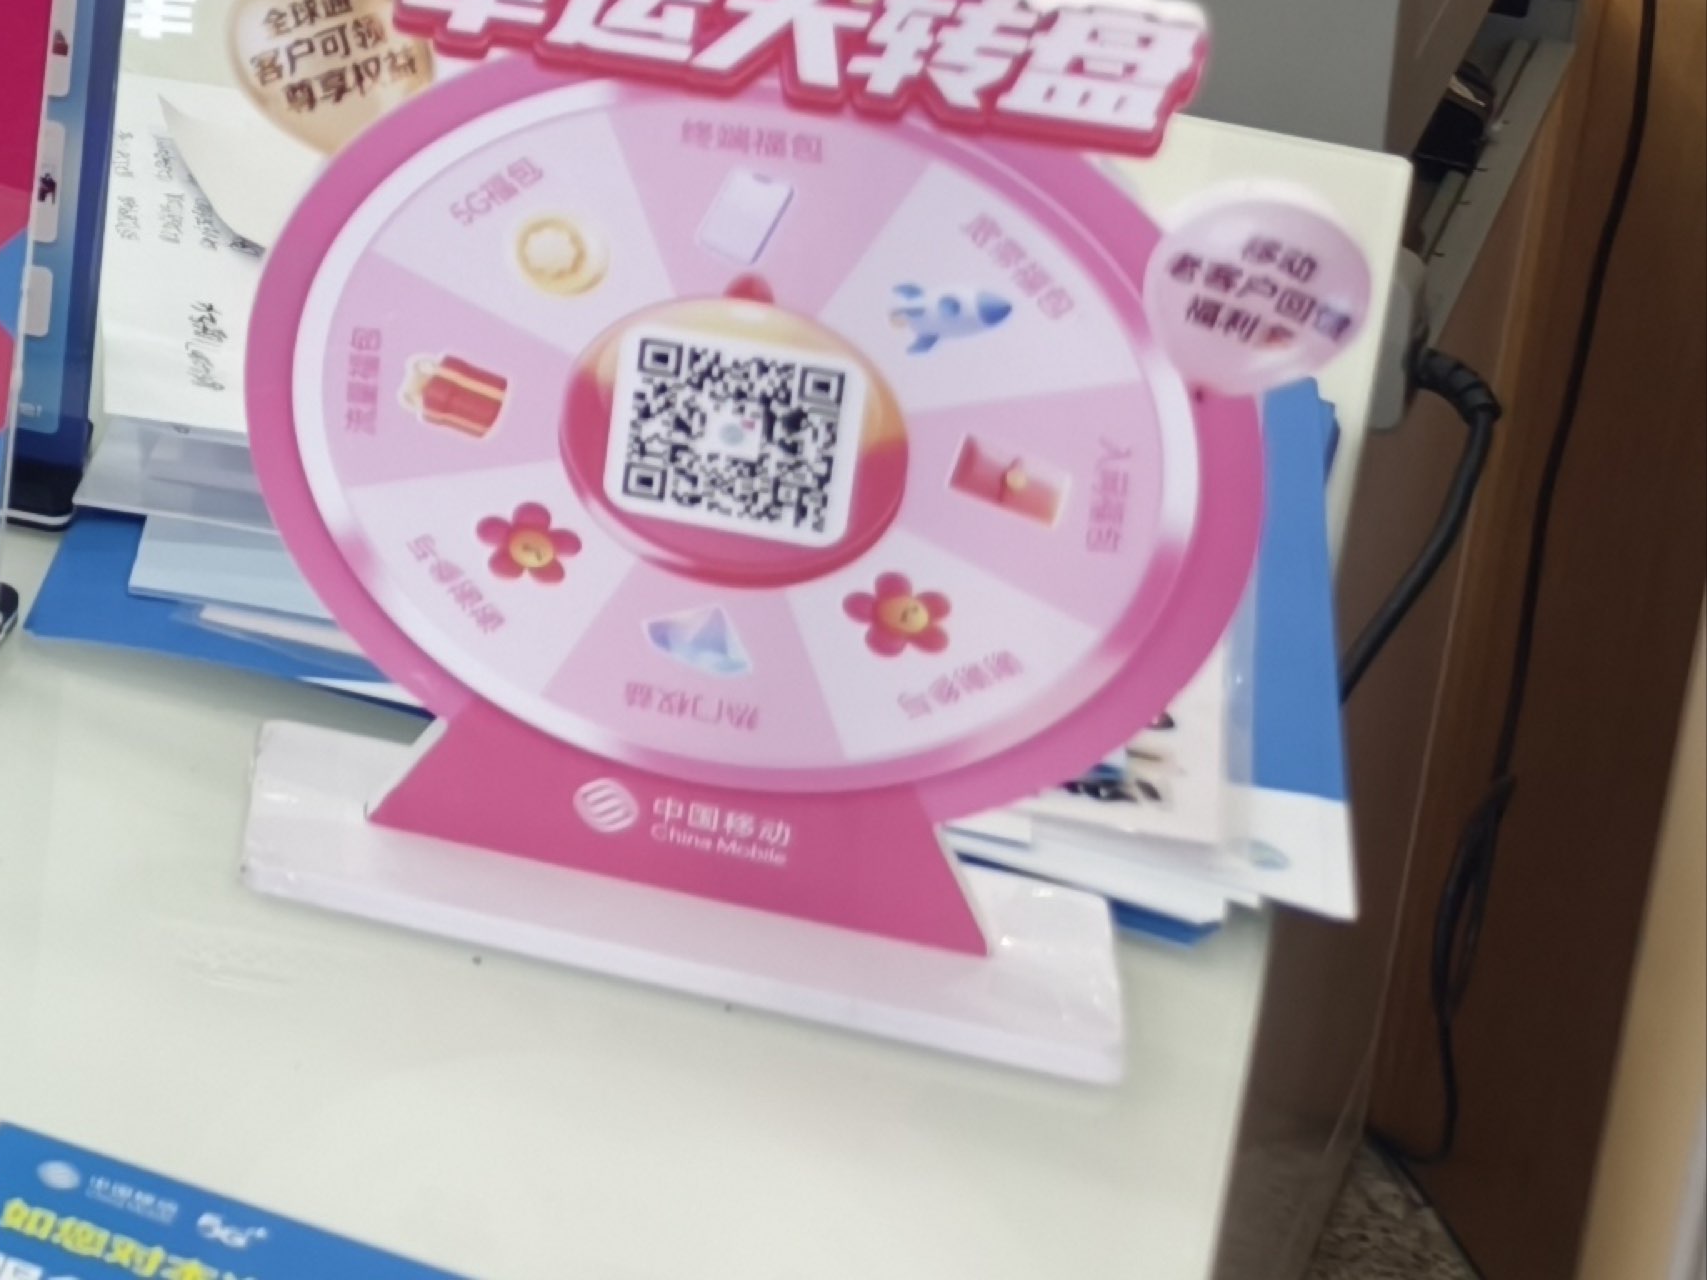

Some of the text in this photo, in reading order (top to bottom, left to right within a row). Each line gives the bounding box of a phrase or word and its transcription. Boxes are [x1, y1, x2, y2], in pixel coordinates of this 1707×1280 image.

[250, 14, 387, 87] 客户可领
[284, 45, 417, 114] 尊享权益
[680, 118, 825, 165] 终端福包
[447, 156, 546, 228] 5G福包
[1242, 235, 1318, 283] 移动
[343, 325, 384, 436] 流量福包
[623, 679, 761, 732] 热门权益
[650, 821, 788, 868] China Mobile
[653, 795, 792, 848] 中国移动
